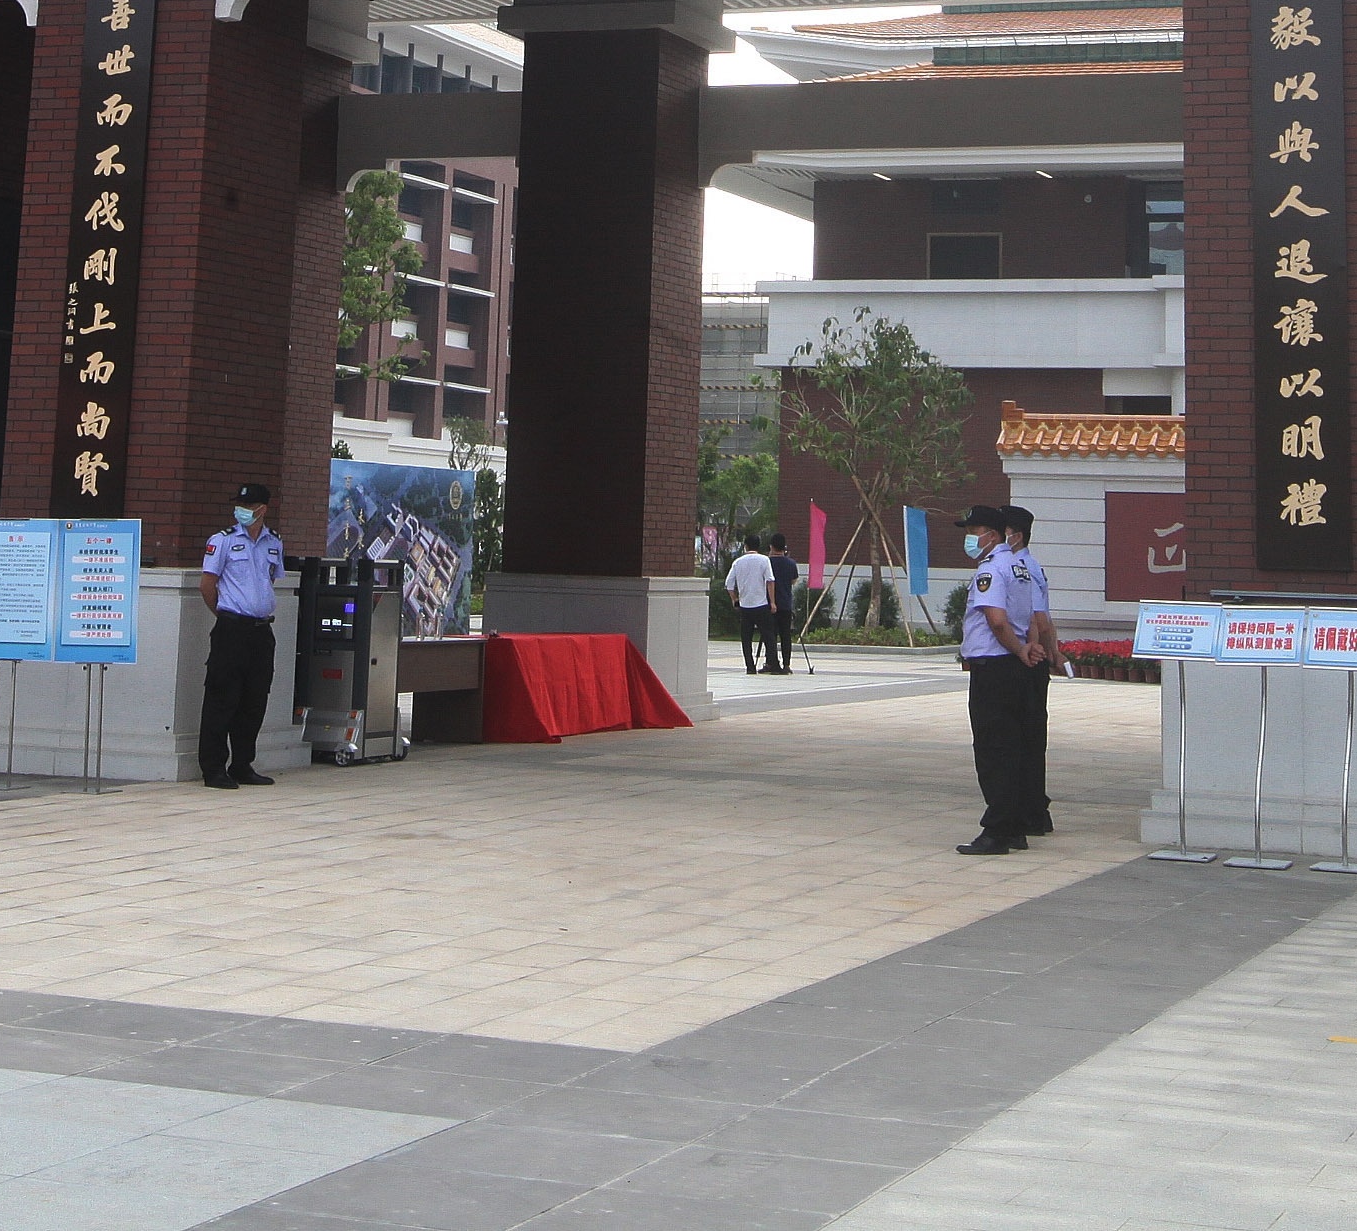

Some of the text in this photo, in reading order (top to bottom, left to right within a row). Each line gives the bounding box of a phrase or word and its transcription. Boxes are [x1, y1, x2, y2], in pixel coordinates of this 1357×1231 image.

[1227, 621, 1296, 636] 请保持间隔一米
[1226, 636, 1294, 651] 排纵队测量体温
